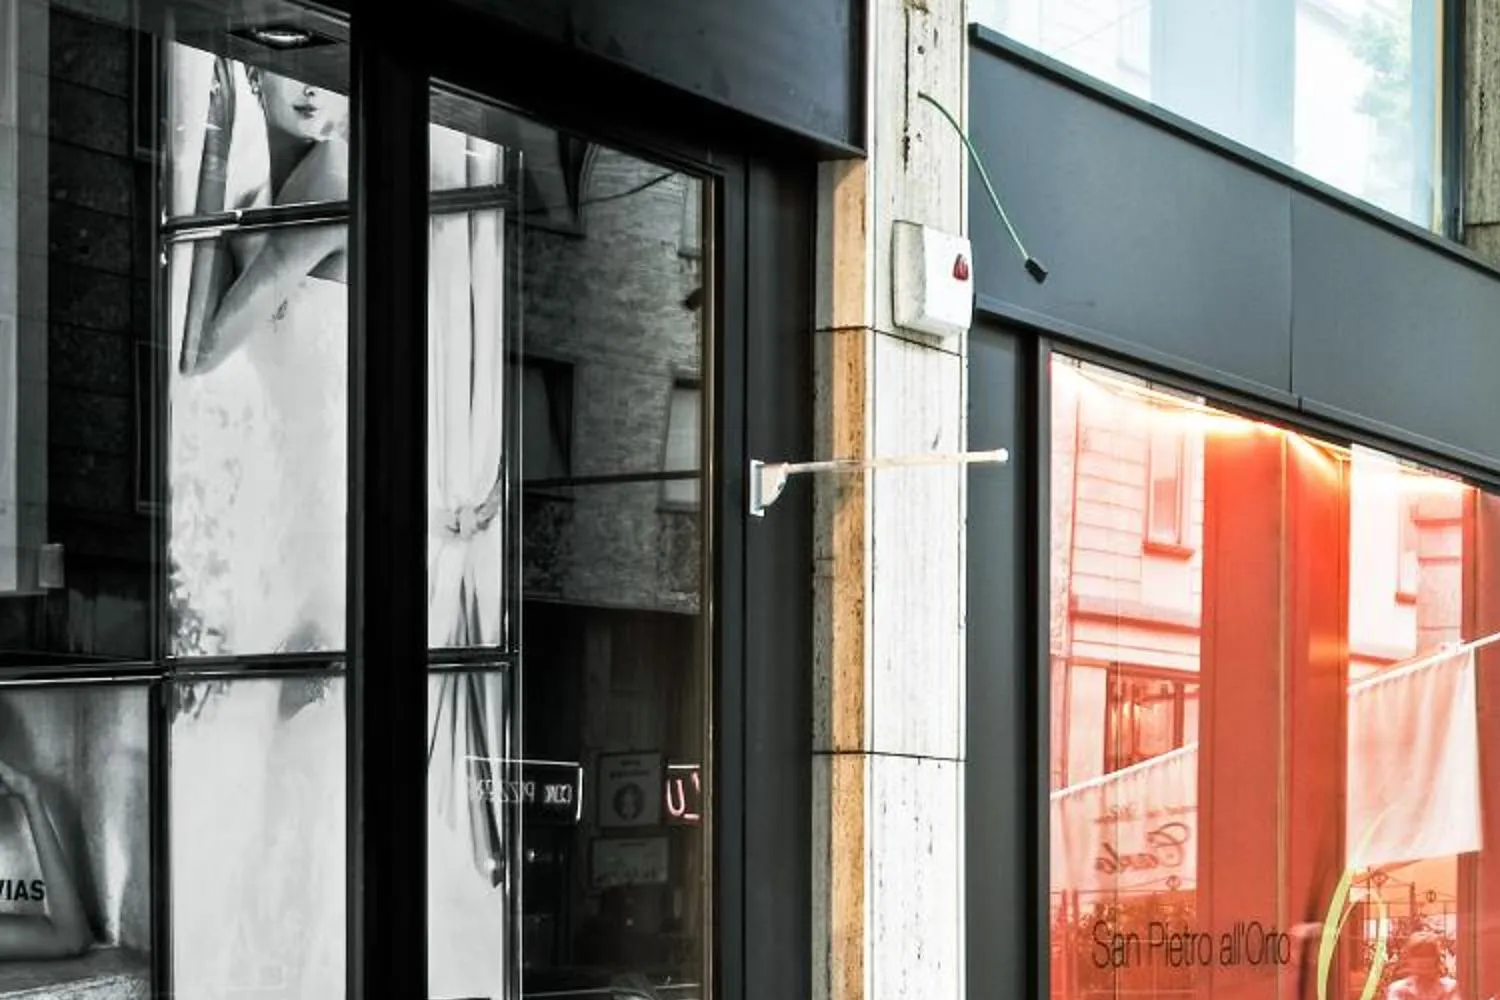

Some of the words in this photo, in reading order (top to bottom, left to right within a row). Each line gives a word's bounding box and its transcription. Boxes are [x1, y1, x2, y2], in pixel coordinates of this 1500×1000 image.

[1092, 919, 1140, 968] San
[1149, 921, 1212, 967] Pietro
[1219, 920, 1291, 966] all'Orto
